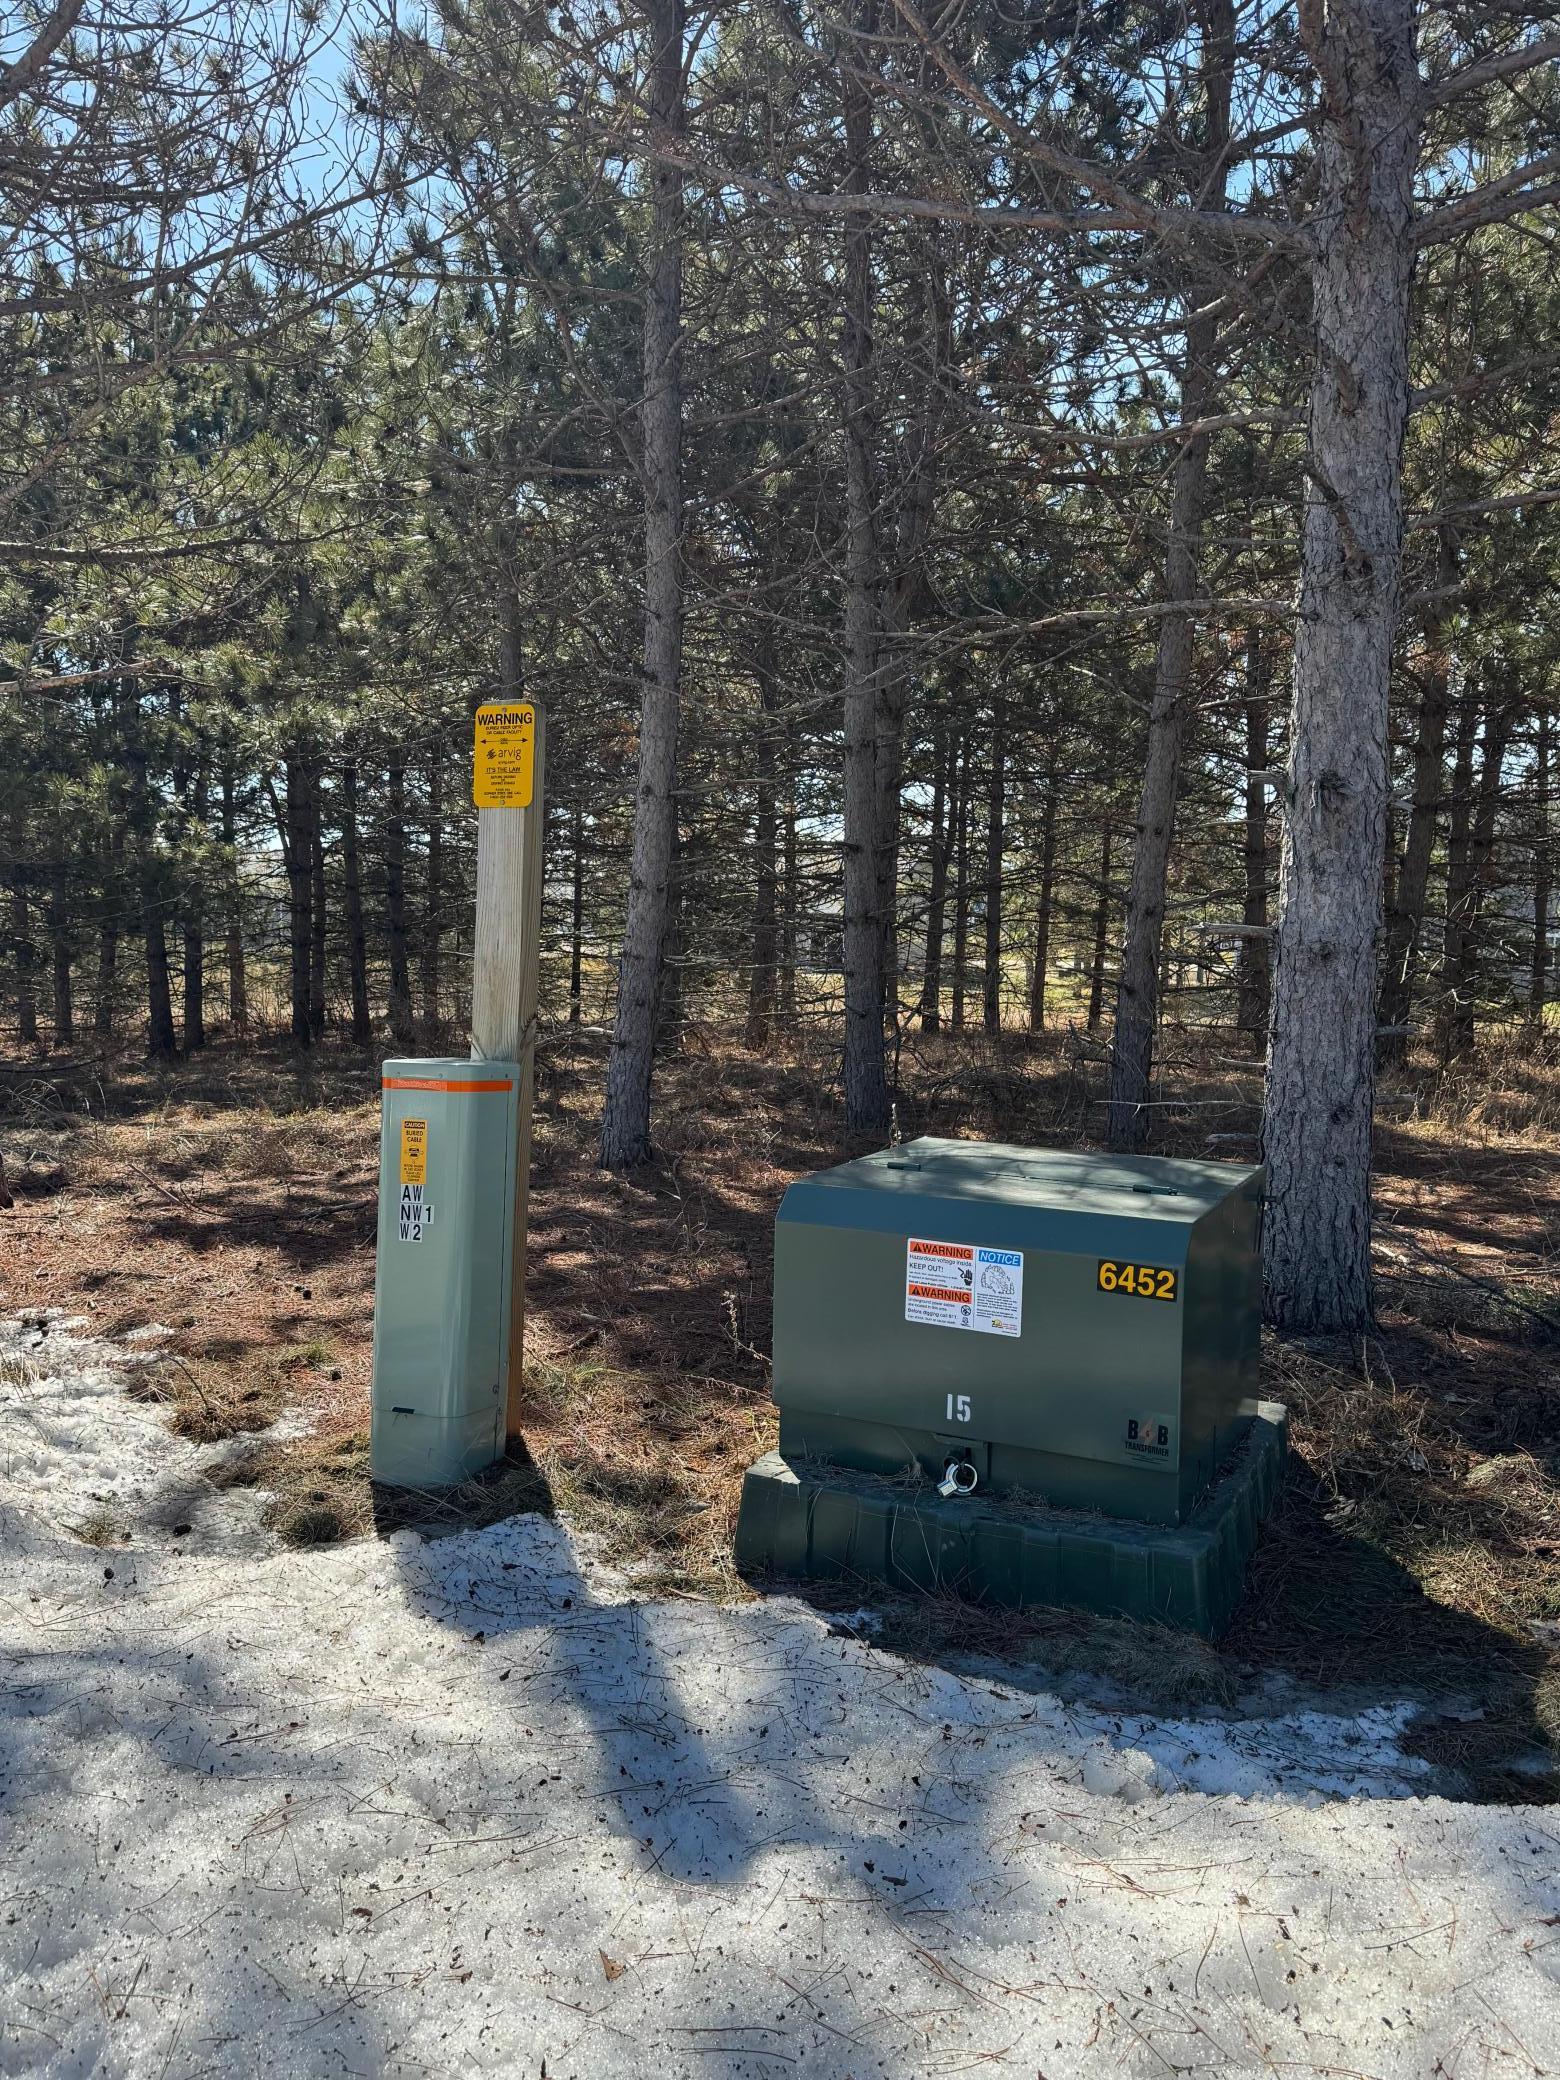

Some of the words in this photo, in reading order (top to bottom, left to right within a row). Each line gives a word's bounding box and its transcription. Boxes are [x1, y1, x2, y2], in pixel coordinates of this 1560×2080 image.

[478, 712, 532, 725] WARNING
[498, 746, 521, 760] arvig
[402, 1185, 422, 1201] AW
[909, 1254, 936, 1262] Hazardous
[922, 1243, 971, 1259] WARNING
[980, 1251, 1019, 1265] NOTICE
[909, 1262, 927, 1270] KEEP
[1099, 1262, 1175, 1299] 6452
[921, 1287, 970, 1303] WARNING
[922, 1310, 940, 1318] digging
[946, 1393, 971, 1422] 15
[1125, 1441, 1169, 1456] TRANSFORMER
